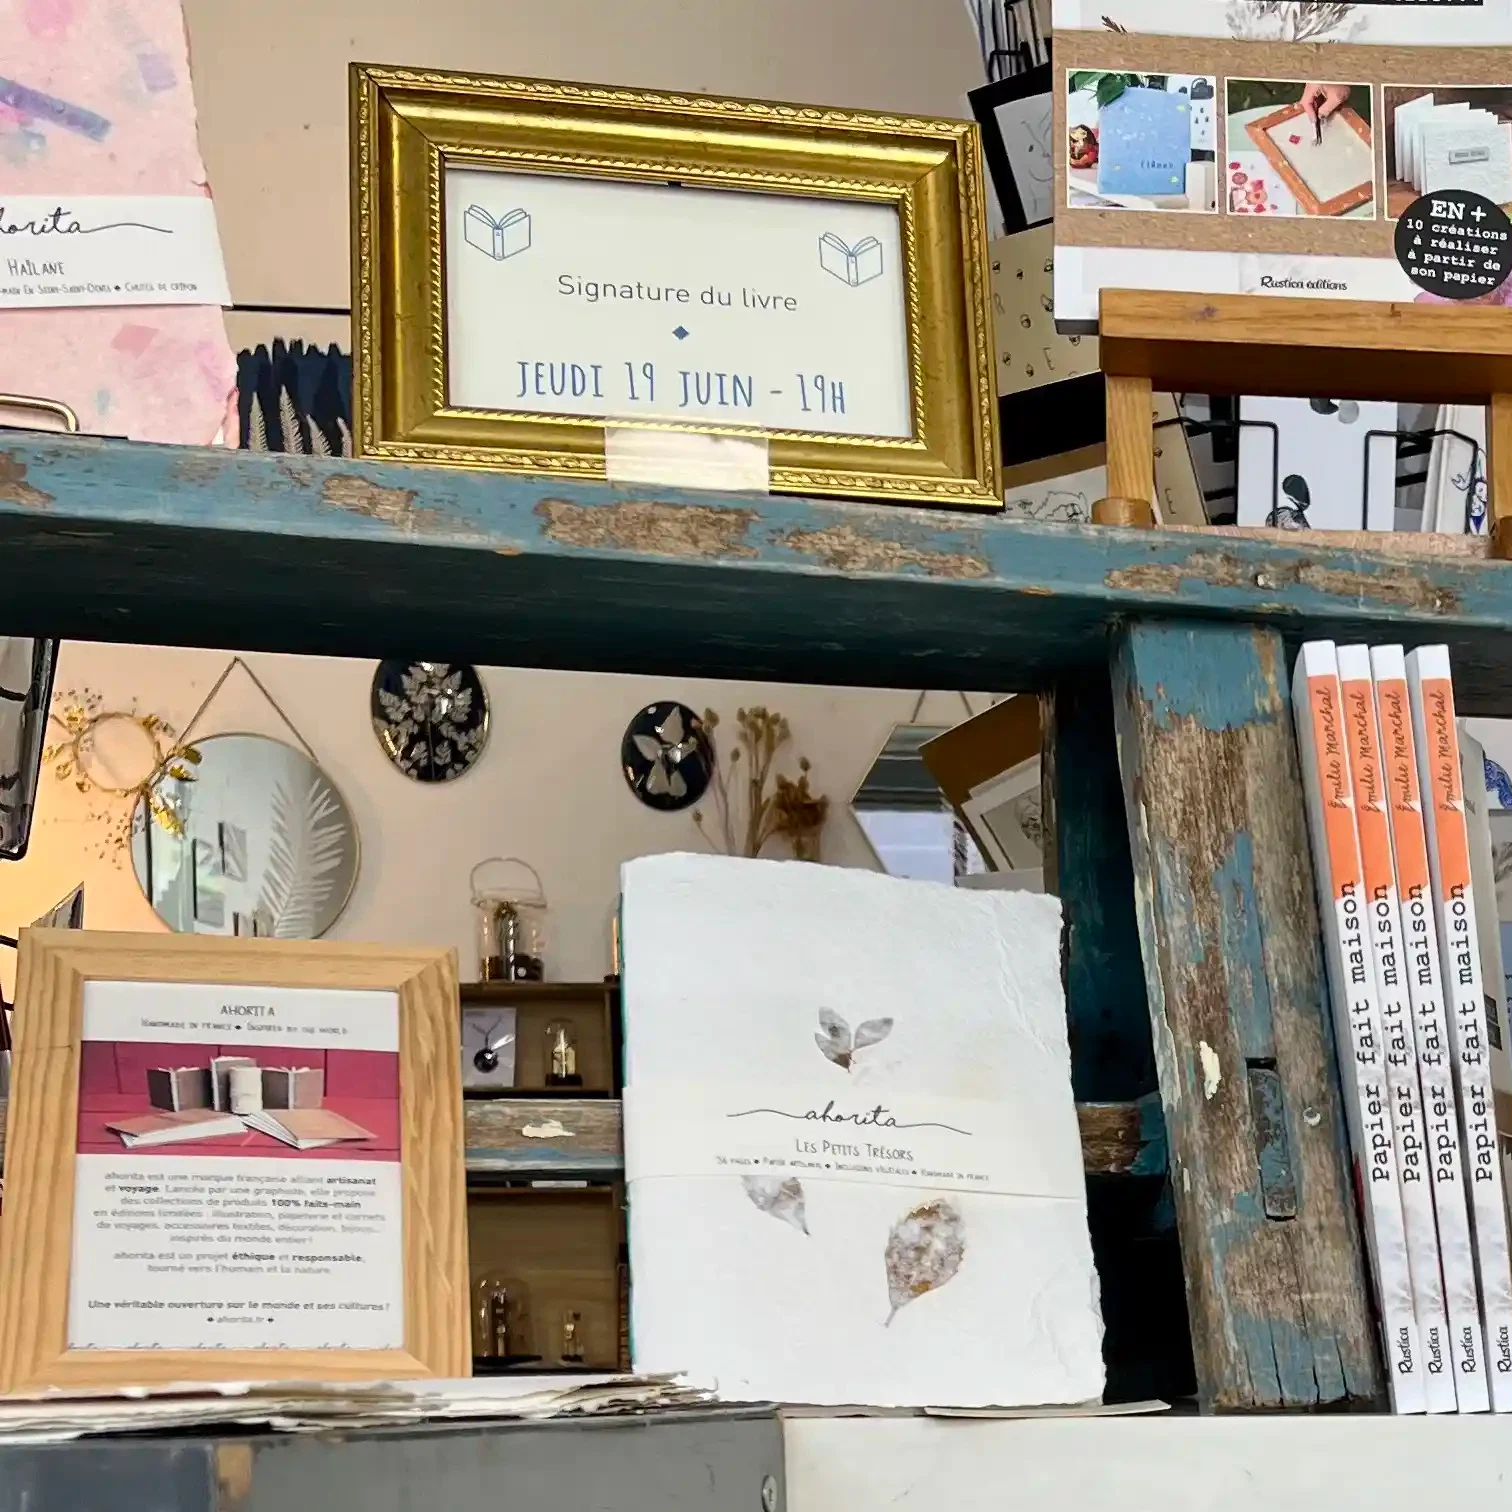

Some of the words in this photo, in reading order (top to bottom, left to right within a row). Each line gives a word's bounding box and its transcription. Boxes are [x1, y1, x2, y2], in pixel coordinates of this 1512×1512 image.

[1406, 218, 1424, 231] 10
[1431, 222, 1508, 241] créations
[1412, 234, 1422, 246] à
[1430, 236, 1499, 254] réaliser
[1430, 199, 1466, 220] EN
[1470, 205, 1487, 222] +
[557, 273, 690, 304] Signature
[700, 286, 732, 307] du
[742, 287, 798, 312] livre
[1260, 275, 1304, 289] Rustica
[1407, 249, 1417, 260] à
[1423, 252, 1476, 269] partir
[1482, 257, 1500, 271] de
[1410, 267, 1436, 278] son
[1443, 269, 1496, 287] papier
[516, 360, 604, 399] JEUDI
[624, 361, 656, 402] 19
[677, 370, 754, 408] JUIN
[796, 374, 847, 414] 19H
[1315, 684, 1342, 755] Marchal
[1349, 690, 1376, 760] Marchal
[1384, 690, 1409, 760] Marchal
[1429, 689, 1454, 760] Marchal
[1341, 882, 1366, 984] maison
[1374, 884, 1398, 986] maison
[1408, 883, 1432, 986] maison
[1450, 883, 1473, 985] maison
[220, 1004, 276, 1017] AHORITA
[1352, 998, 1376, 1065] fait
[1384, 1000, 1407, 1067] fait
[1418, 999, 1442, 1067] fait
[1458, 999, 1481, 1066] fait
[804, 1100, 899, 1128] ahorita
[1365, 1084, 1392, 1183] Papier
[1396, 1085, 1422, 1184] Papier
[1430, 1085, 1456, 1183] Papier
[1468, 1084, 1495, 1183] Papier
[1398, 1326, 1414, 1374] Rustica
[1428, 1326, 1444, 1375] Rustica
[1461, 1326, 1477, 1374] Rustica
[1496, 1325, 1512, 1374] Rustica
